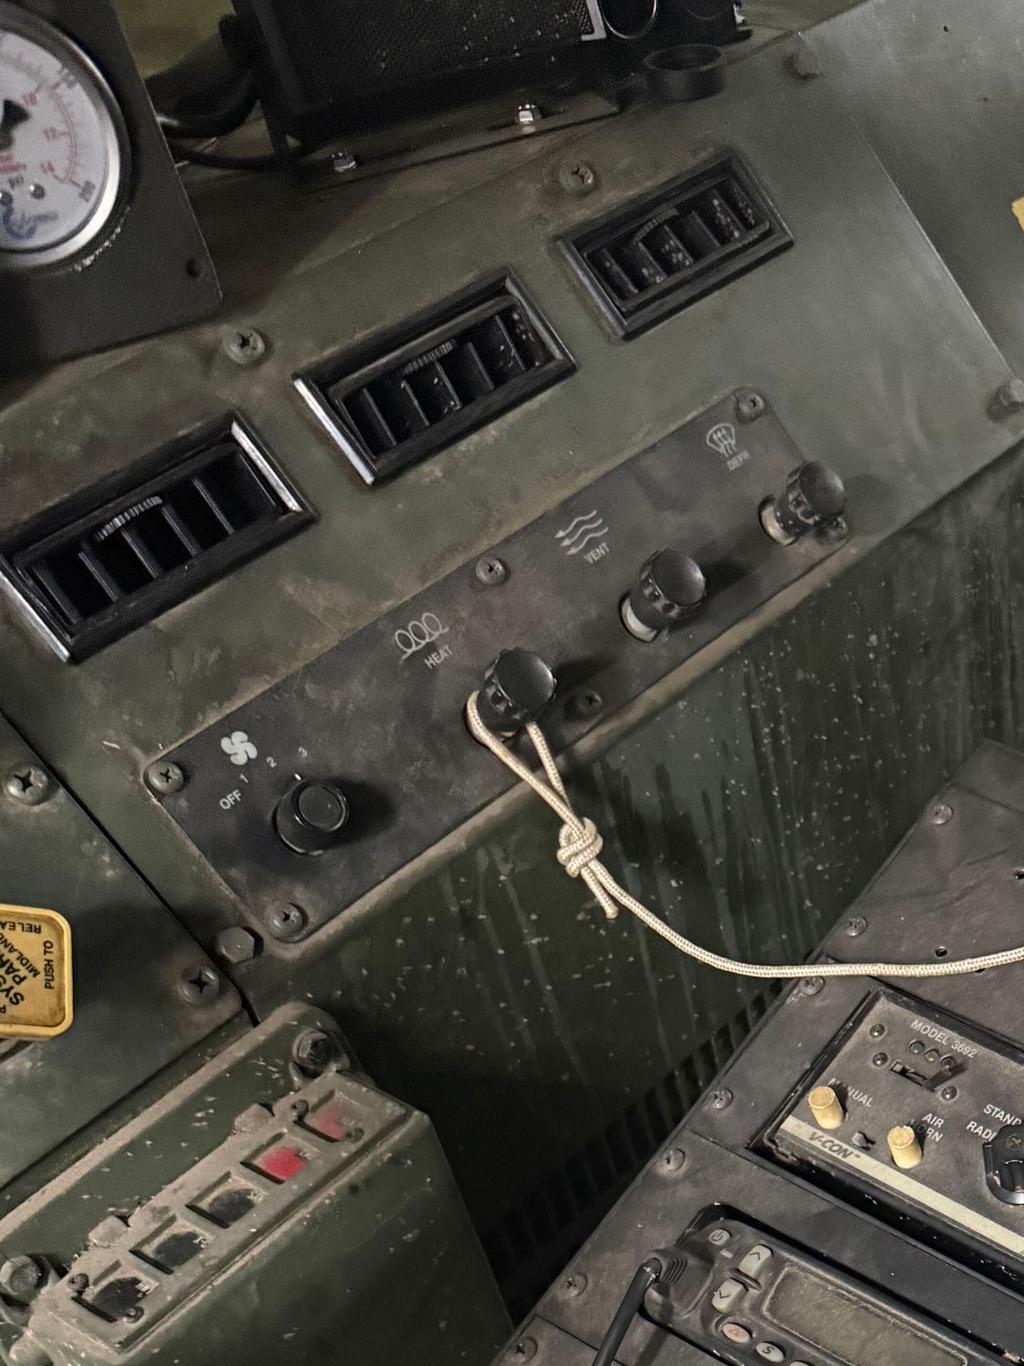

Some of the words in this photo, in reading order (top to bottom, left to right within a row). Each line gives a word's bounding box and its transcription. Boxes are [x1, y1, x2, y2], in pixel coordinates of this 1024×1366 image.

[584, 542, 611, 565] VENT
[423, 646, 455, 669] HEAT
[266, 756, 277, 768] 2
[298, 746, 308, 758] 3
[239, 773, 249, 784] 1
[219, 789, 242, 810] OFF
[43, 940, 54, 956] TO
[44, 958, 55, 990] PUSH
[909, 1019, 950, 1046] MODEL
[951, 1040, 978, 1059] 3692
[827, 1077, 874, 1109] MNUAL
[921, 1112, 945, 1129] AIR
[966, 1120, 997, 1142] RADI
